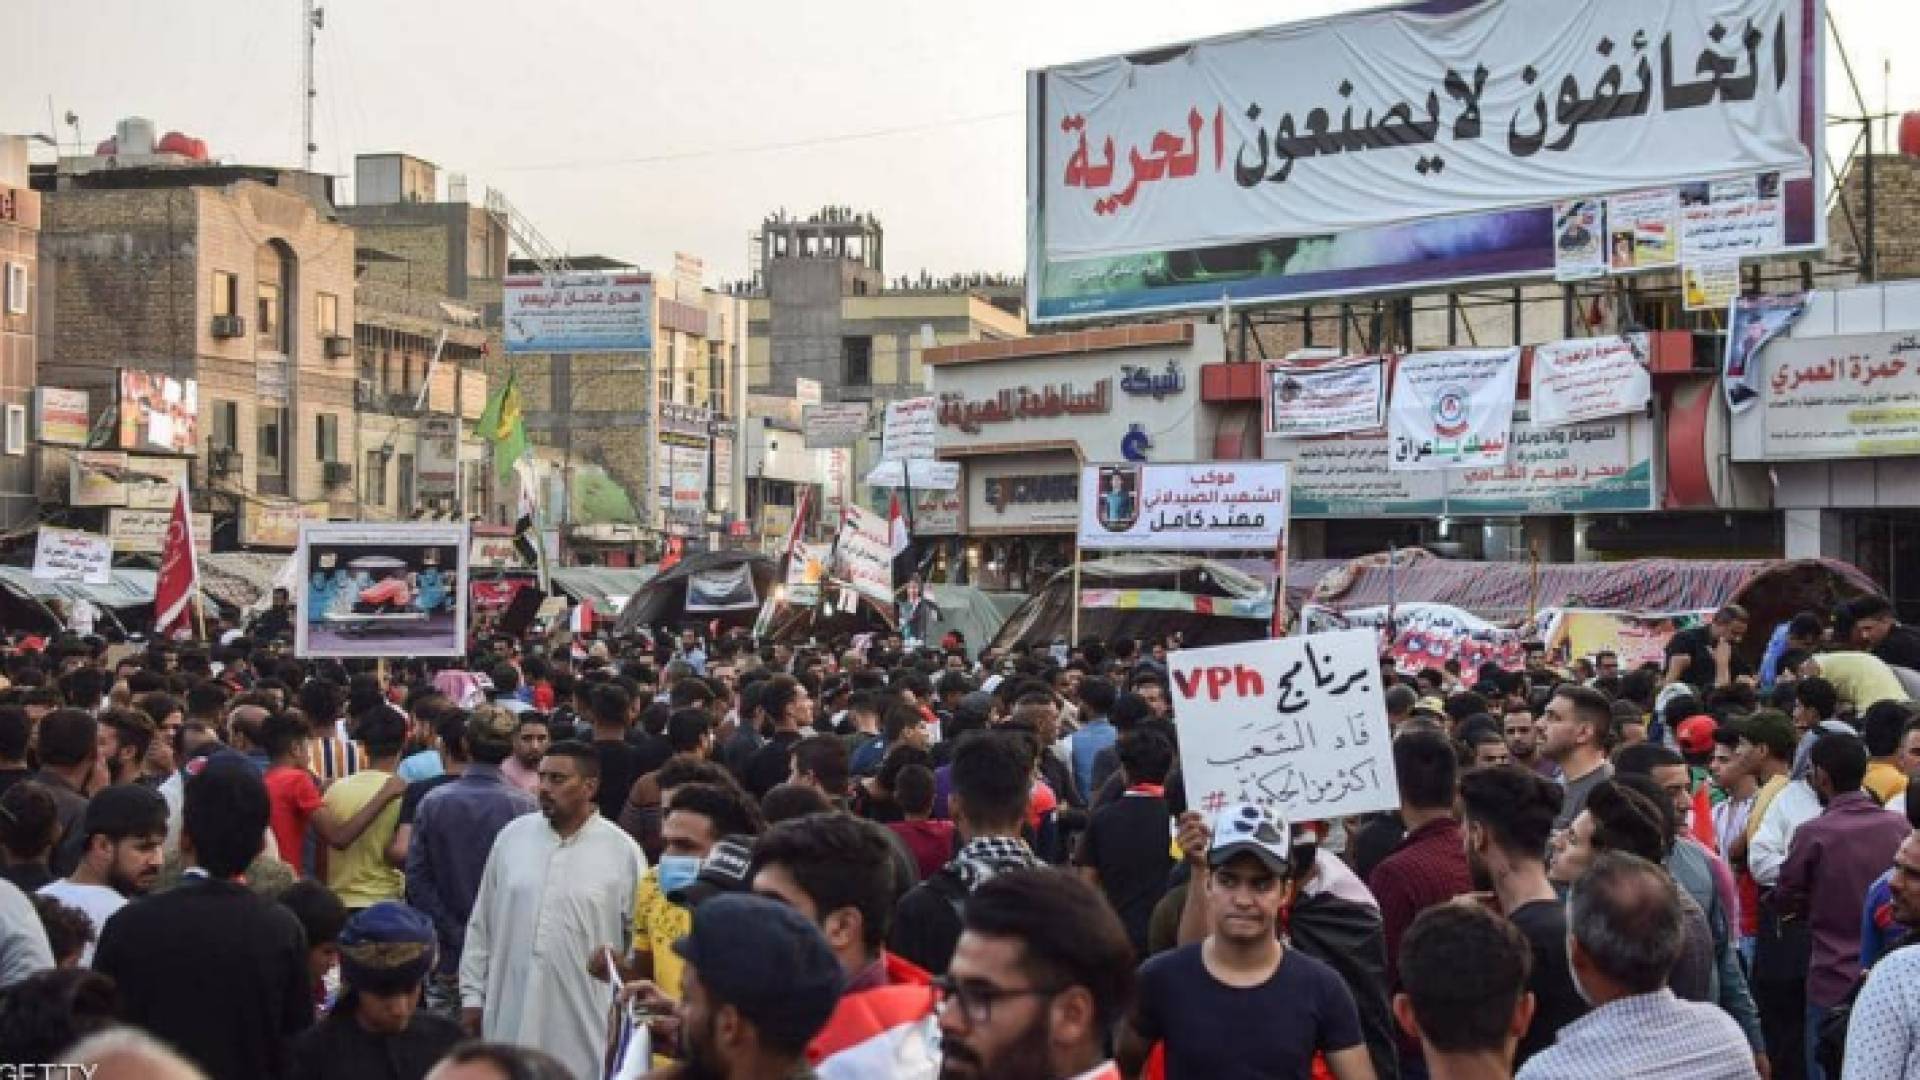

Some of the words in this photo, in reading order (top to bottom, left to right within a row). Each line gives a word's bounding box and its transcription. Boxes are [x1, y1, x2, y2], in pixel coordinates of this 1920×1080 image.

[1508, 12, 1787, 157] الخائفون
[1061, 102, 1224, 216] الحرية
[1120, 358, 1186, 402] شركة
[1771, 356, 1845, 395] العمري
[1850, 353, 1907, 386] حمزة
[1395, 436, 1432, 462] عراق
[1464, 431, 1505, 457] لبيك
[1190, 469, 1235, 489] موكب
[1144, 488, 1219, 509] الصيدلاني
[1222, 486, 1281, 503] الشهيد
[1150, 510, 1205, 533] كامل
[1277, 642, 1370, 714] برنامج
